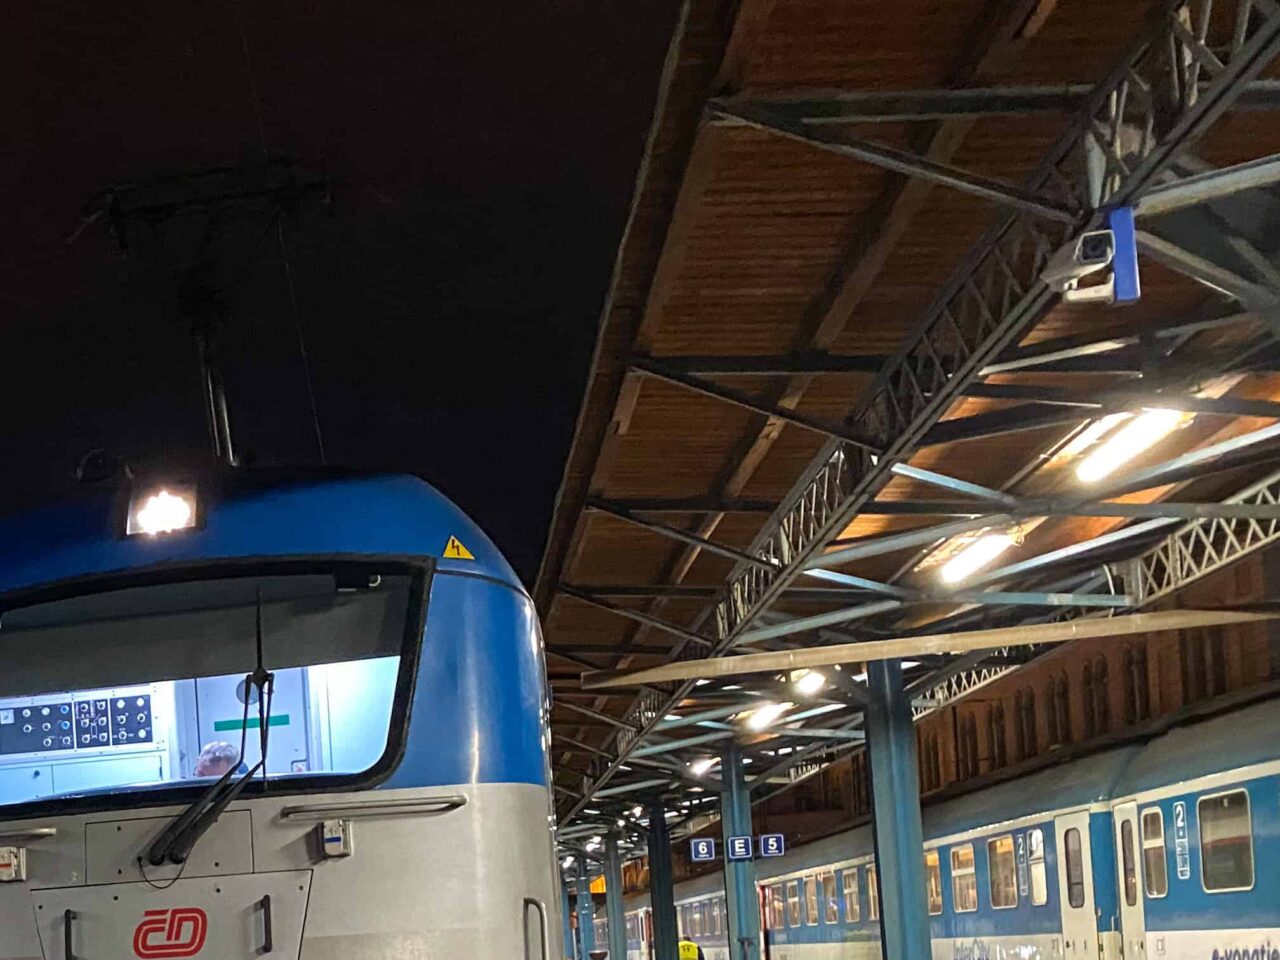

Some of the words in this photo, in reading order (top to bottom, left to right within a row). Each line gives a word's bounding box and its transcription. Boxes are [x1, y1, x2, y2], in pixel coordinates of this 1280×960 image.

[1175, 805, 1185, 828] 2
[698, 842, 708, 854] 6
[734, 839, 746, 853] E
[768, 837, 777, 850] 5
